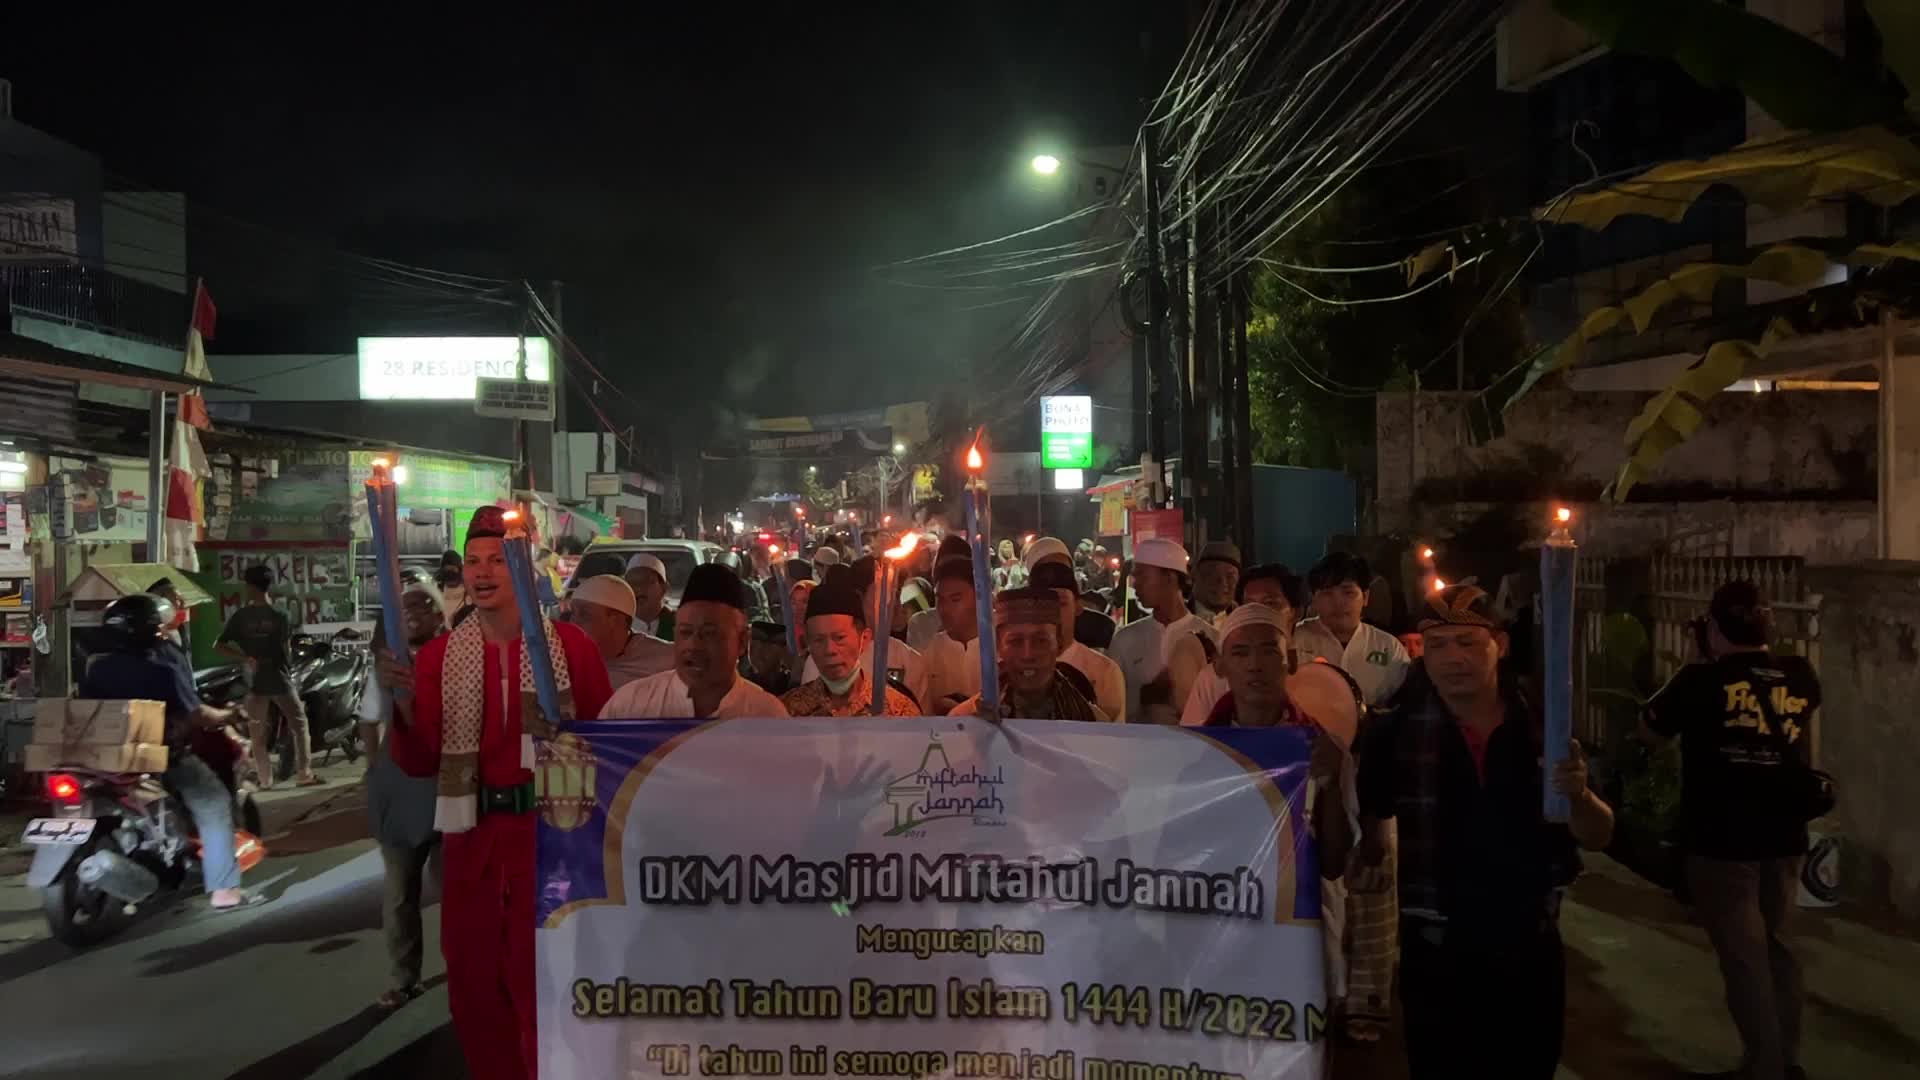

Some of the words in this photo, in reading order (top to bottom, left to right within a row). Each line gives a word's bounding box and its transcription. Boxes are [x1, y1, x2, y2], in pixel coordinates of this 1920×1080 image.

[411, 359, 527, 377] RESIDENC
[641, 856, 741, 904] DKM
[751, 856, 901, 908] Masjid
[912, 854, 1096, 904] Miftahul
[1103, 859, 1262, 920] Jannah
[857, 924, 1044, 958] Mengucapkan
[573, 976, 722, 1018] Selamat
[731, 979, 840, 1017] Tahun
[850, 978, 935, 1018] Baru
[947, 977, 1048, 1018] Islam
[1062, 982, 1149, 1026] 1444
[1160, 988, 1294, 1041] H/2022
[698, 1044, 782, 1076] tahun
[791, 1045, 826, 1076] ini
[834, 1051, 947, 1080] semoga
[955, 1048, 1073, 1080] menjadi
